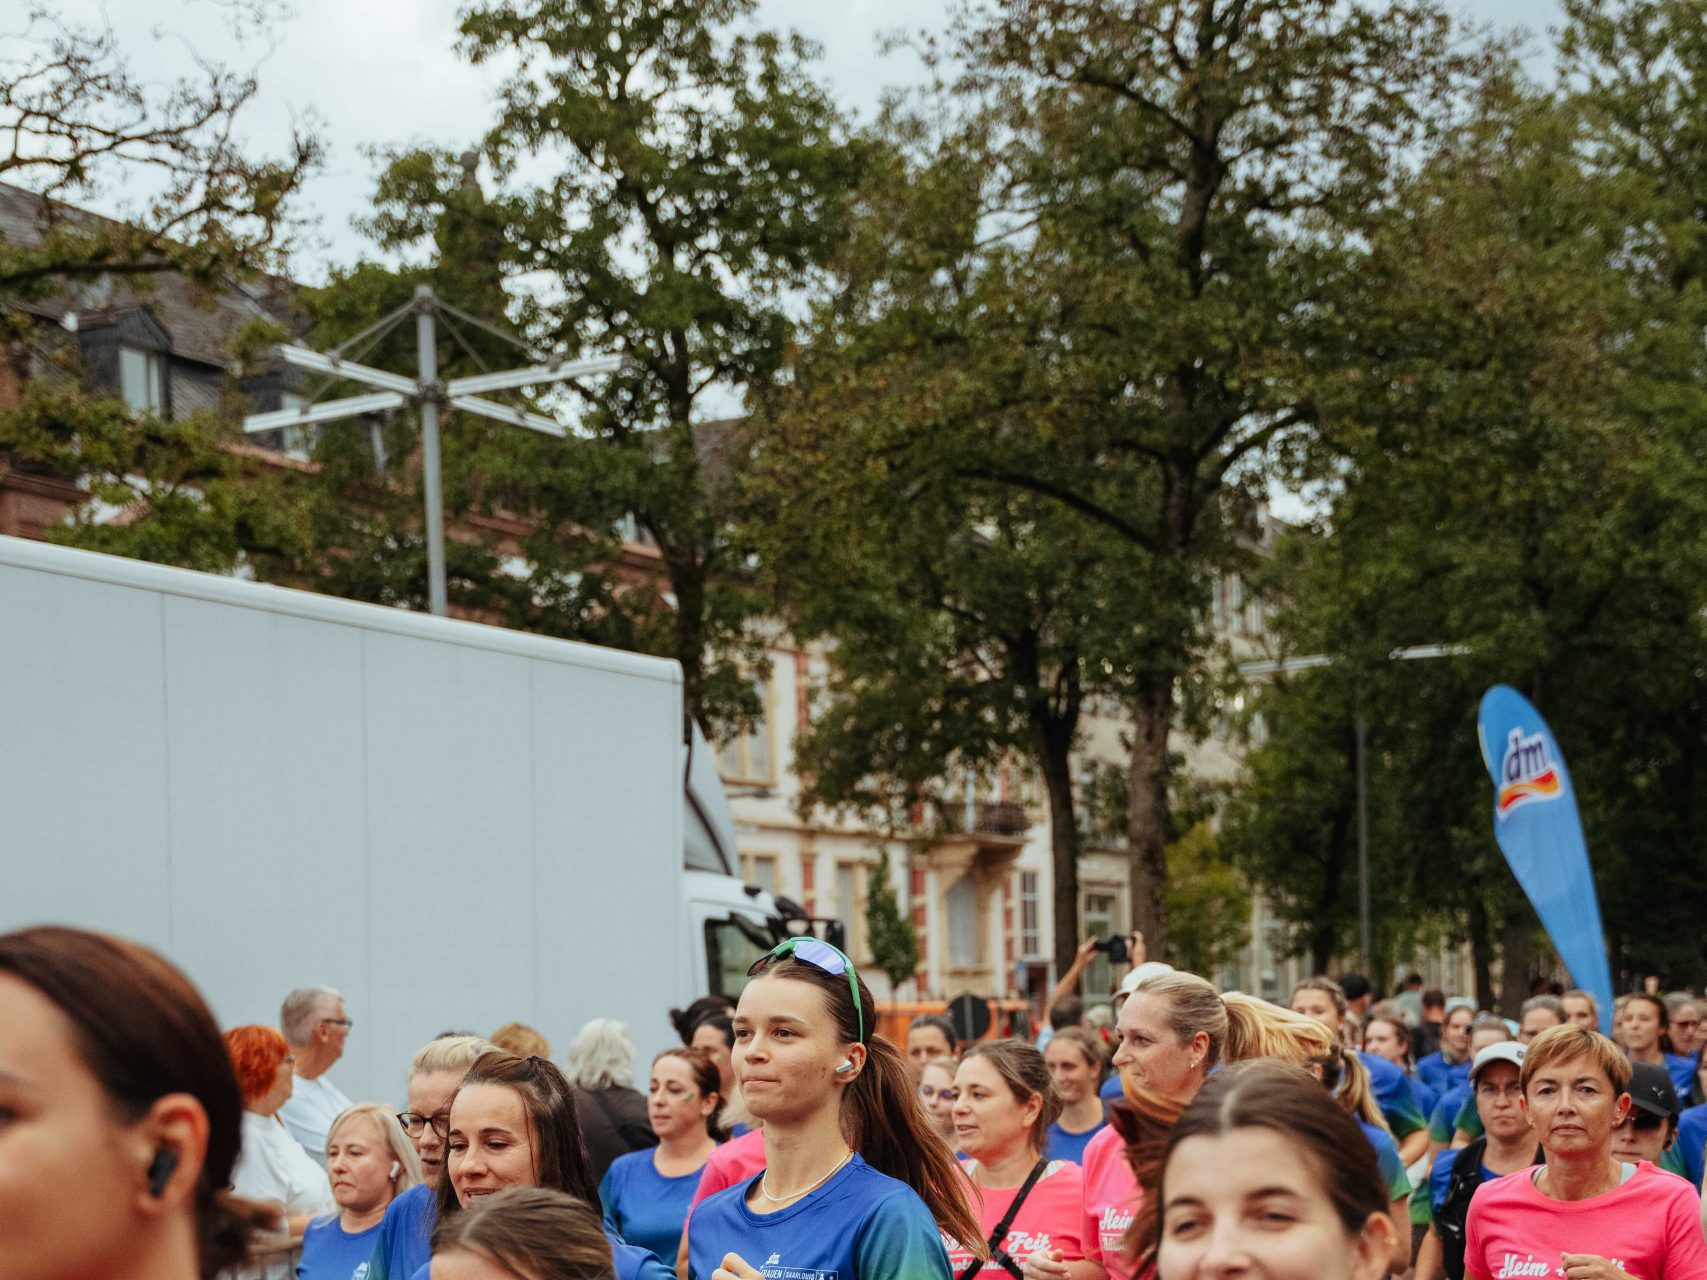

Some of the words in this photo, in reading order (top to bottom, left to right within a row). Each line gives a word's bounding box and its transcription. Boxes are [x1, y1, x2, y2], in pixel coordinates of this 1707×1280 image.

[1506, 736, 1547, 781] dm
[1007, 1230, 1052, 1253] Feit
[1499, 1253, 1550, 1279] Heim
